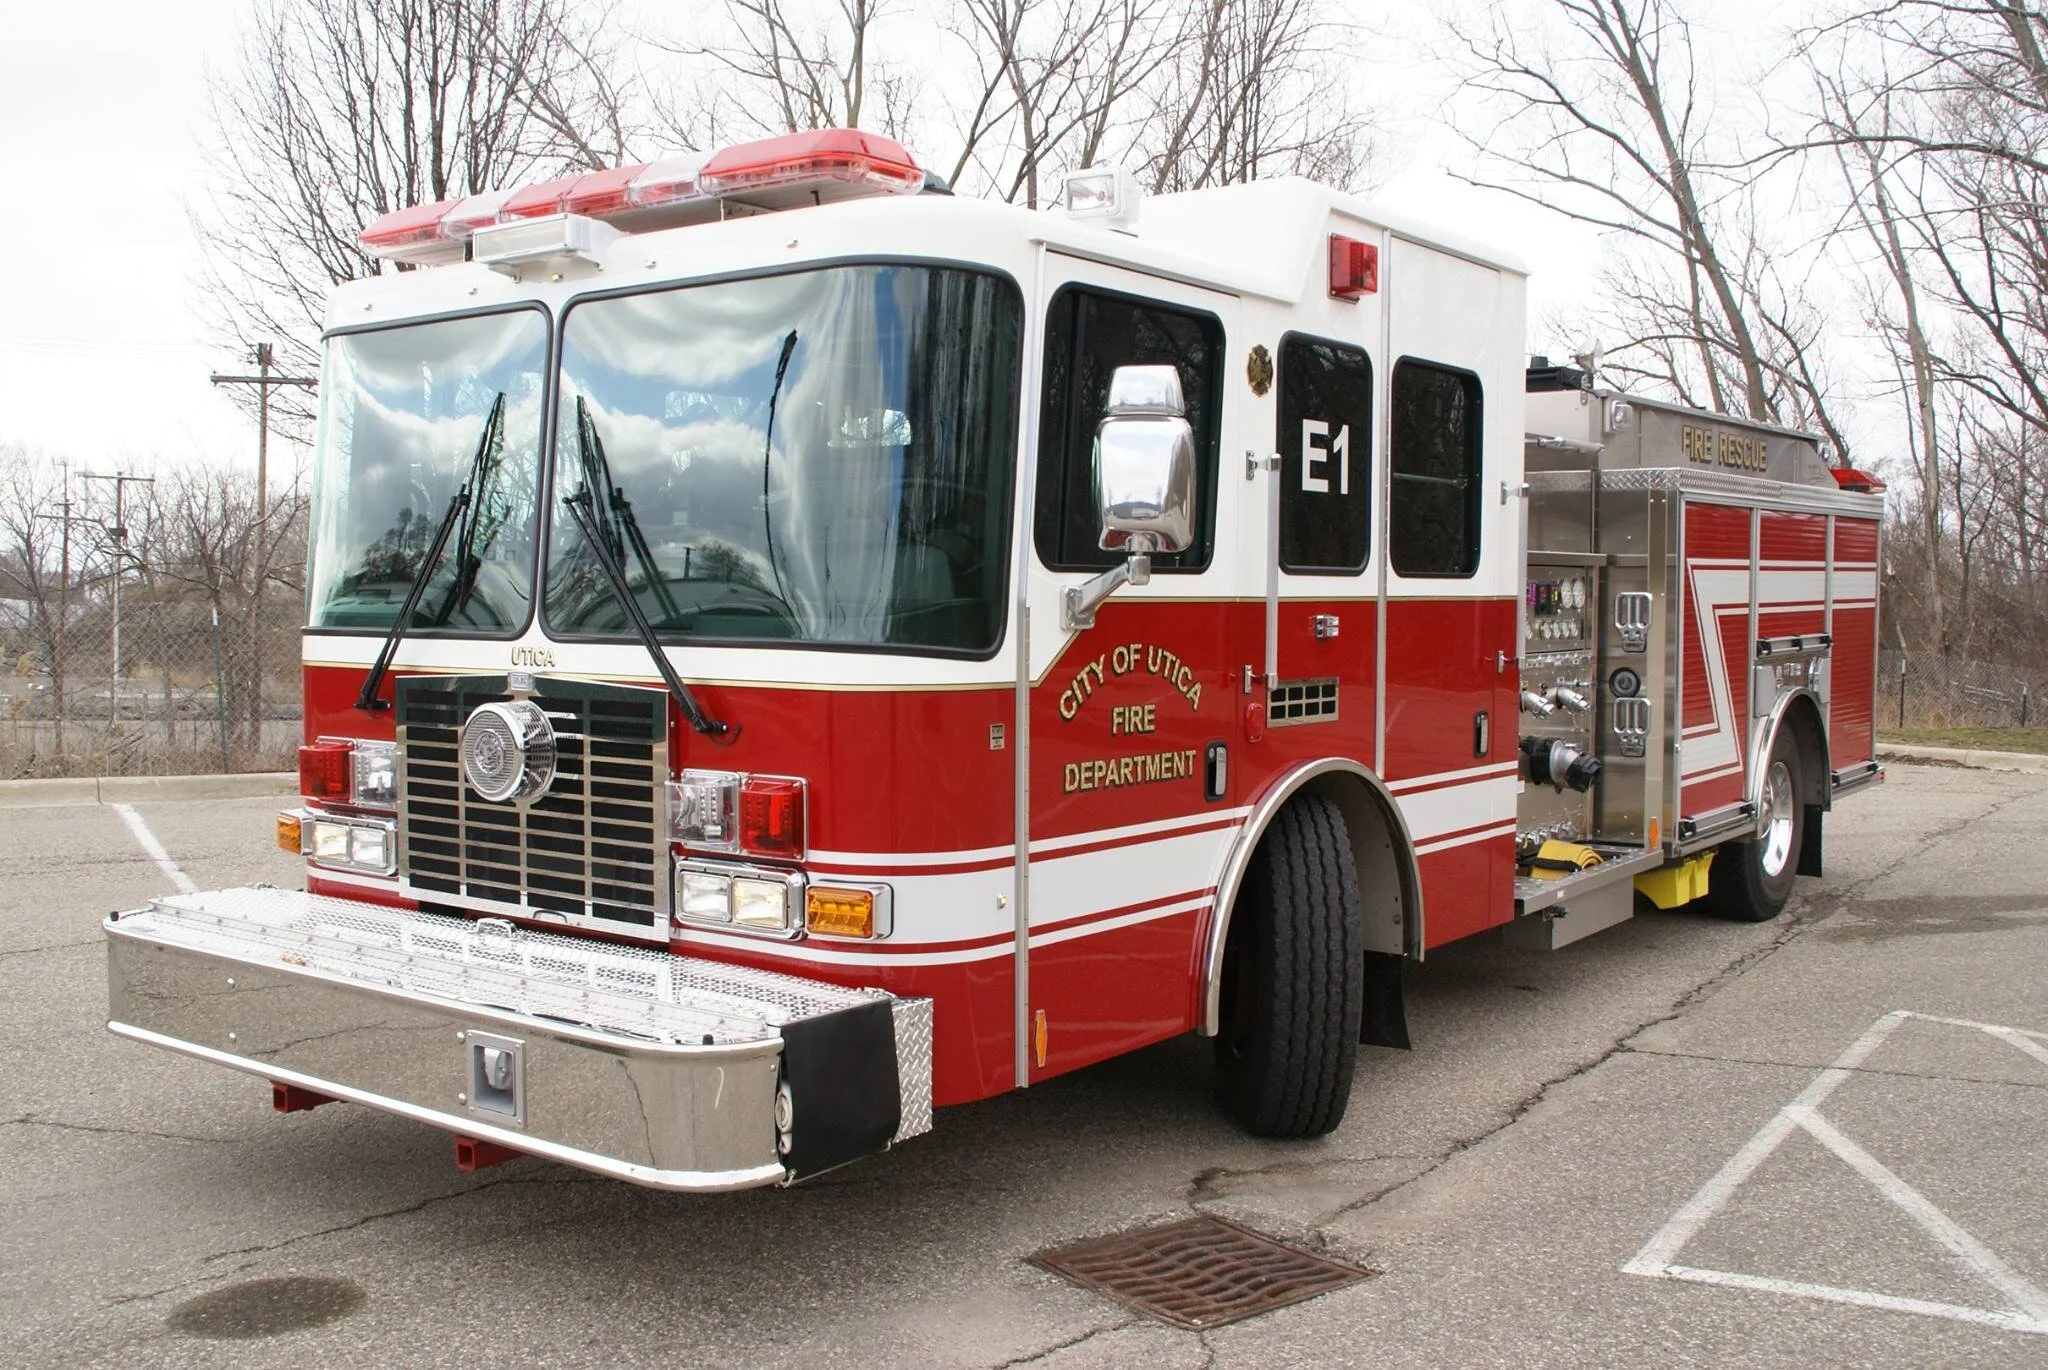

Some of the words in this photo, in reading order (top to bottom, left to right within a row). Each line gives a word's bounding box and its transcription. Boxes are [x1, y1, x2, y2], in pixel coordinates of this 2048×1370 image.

[1302, 418, 1349, 495] E1
[1682, 425, 1713, 464] FIRE
[1718, 432, 1767, 472] RESCUE
[511, 646, 556, 667] UTICA
[1059, 654, 1105, 721] CITY
[1112, 643, 1142, 676] OF
[1147, 645, 1203, 711] UTICA
[1112, 703, 1156, 735] FIRE
[1064, 749, 1197, 793] DEPARTMENT
